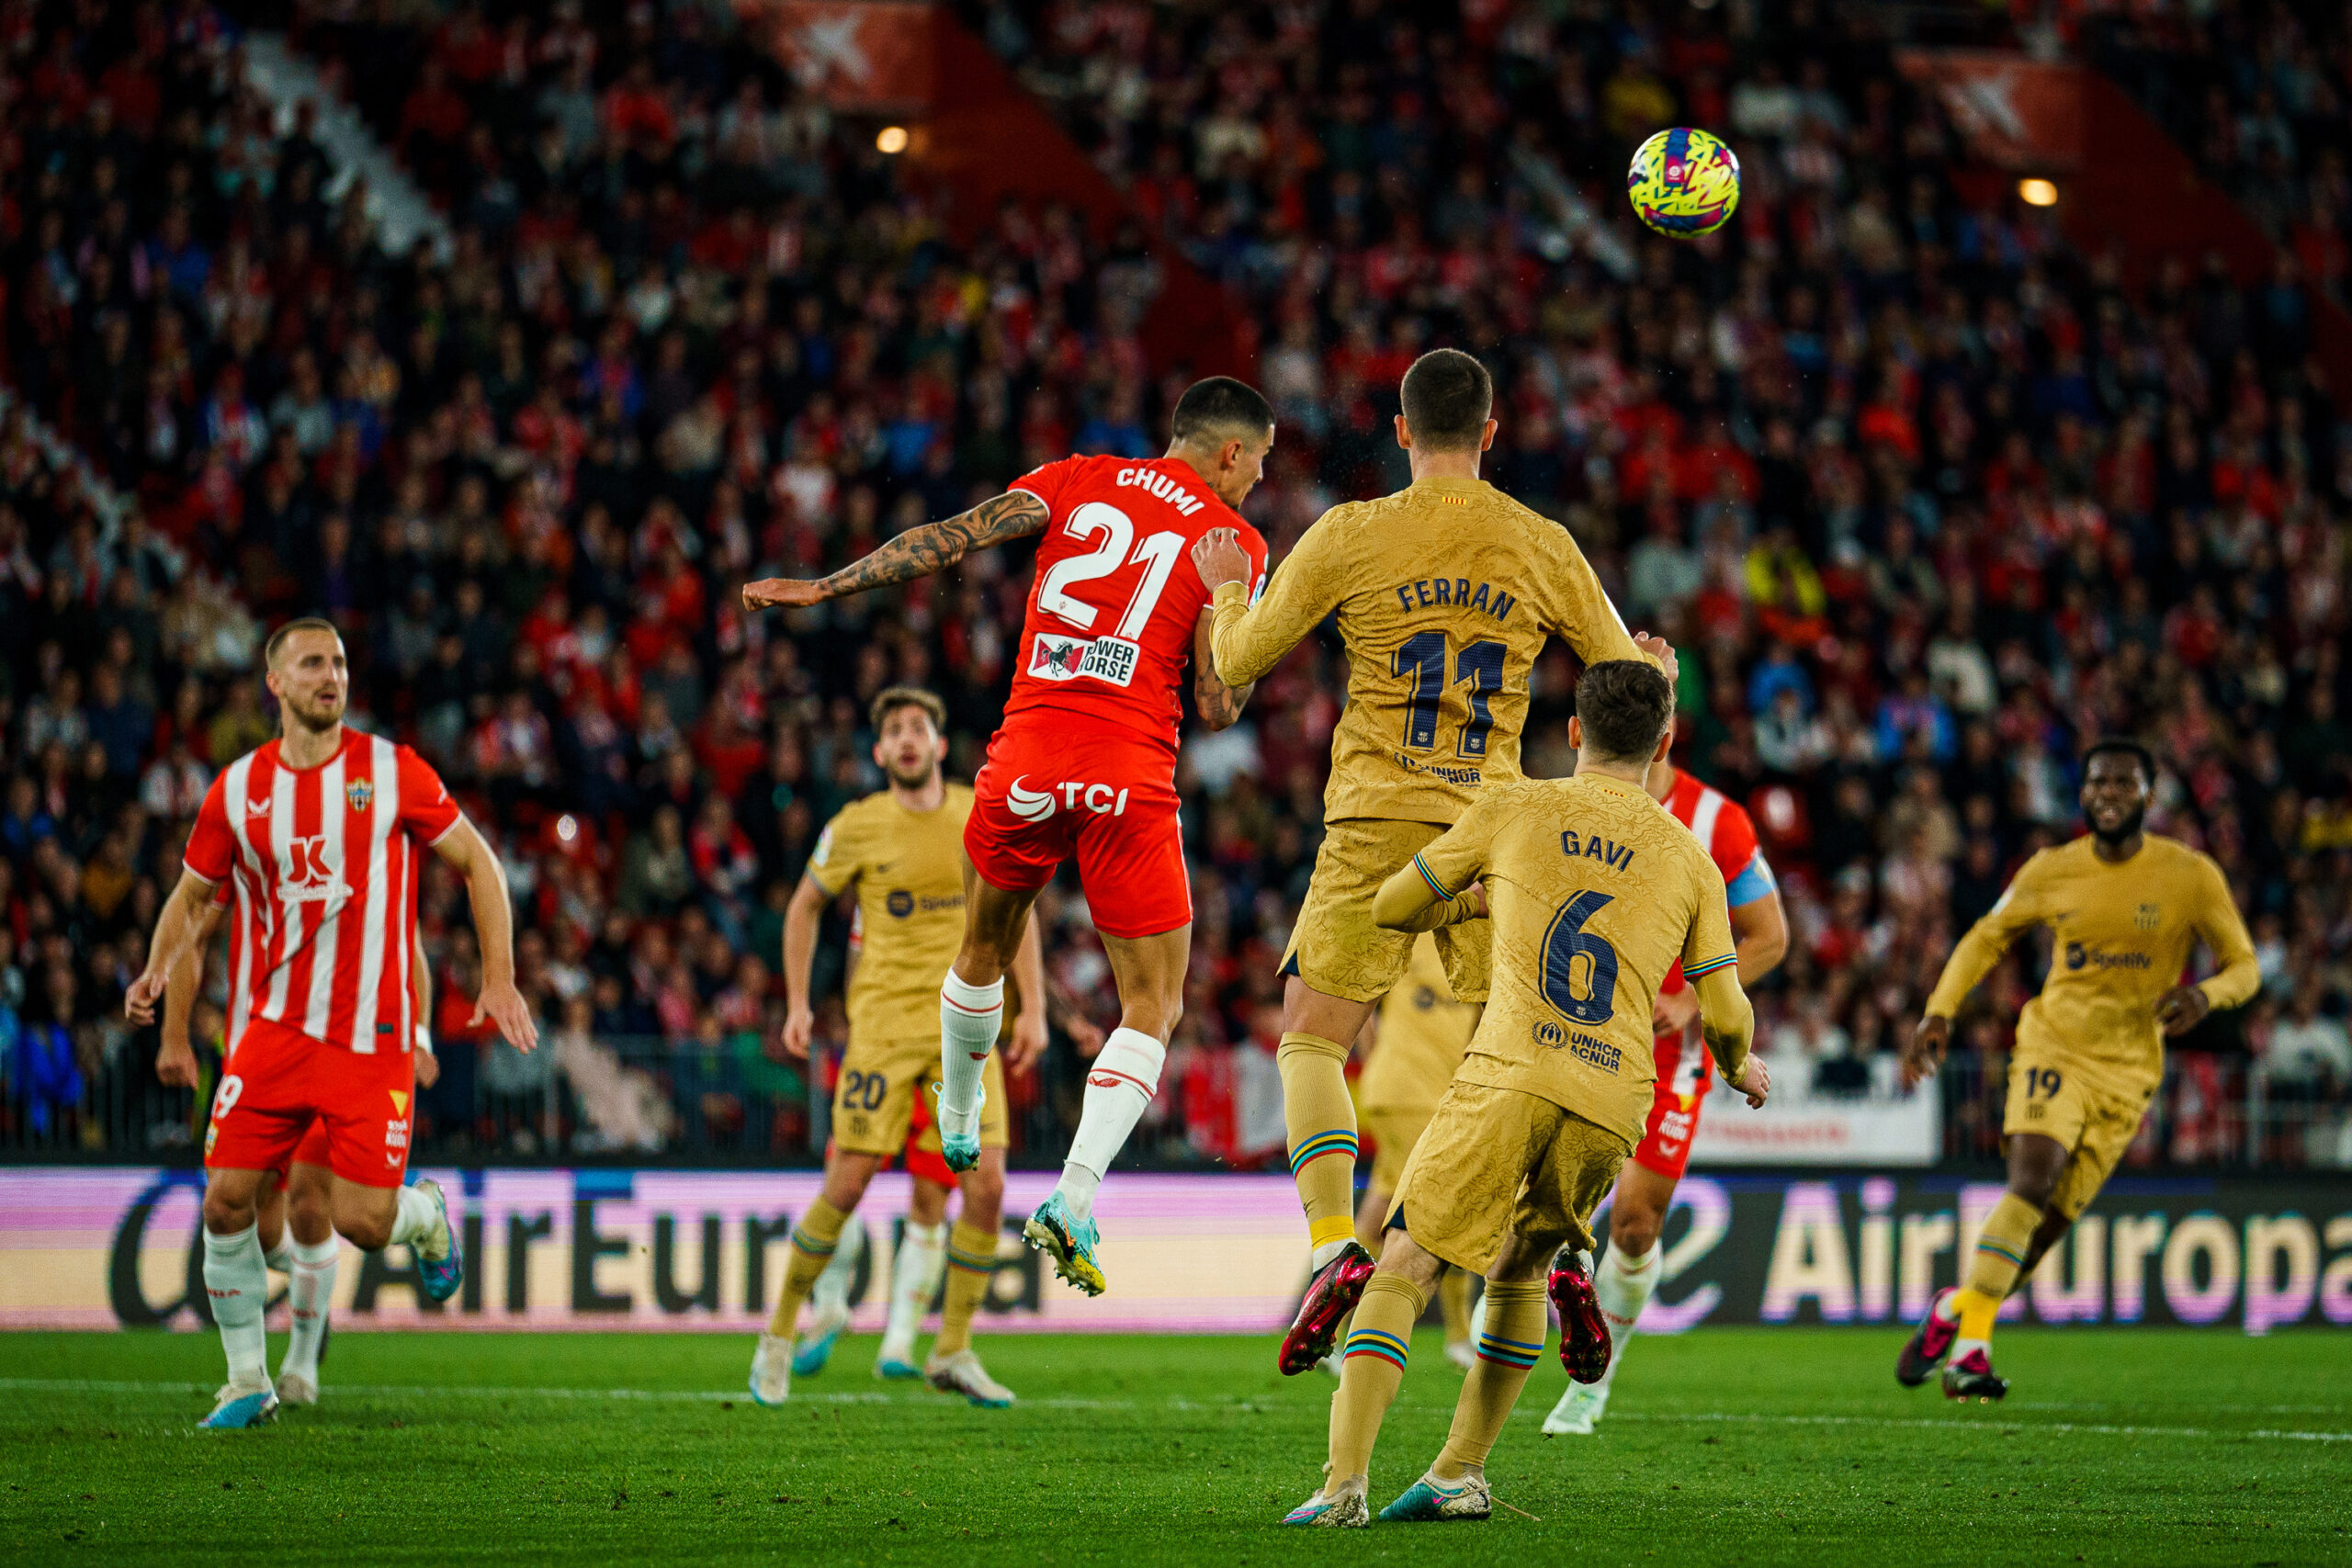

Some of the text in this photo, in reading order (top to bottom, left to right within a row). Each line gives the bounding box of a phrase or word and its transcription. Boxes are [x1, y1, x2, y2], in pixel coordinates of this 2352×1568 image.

[1115, 468, 1205, 516] CHUMI
[1037, 502, 1186, 641] 21
[1396, 577, 1517, 622] FERRAN
[1077, 655, 1130, 682] ORSE
[1391, 631, 1508, 760] 11
[1440, 772, 1481, 784] NUR
[1057, 782, 1129, 817] TCI
[287, 838, 333, 884] JK
[1561, 830, 1634, 872] GAVI
[1538, 888, 1619, 1026] 6
[1570, 1044, 1620, 1072] ACNUR
[1571, 1032, 1623, 1061] UNHCR
[842, 1070, 887, 1111] 20
[2026, 1066, 2062, 1099] 19
